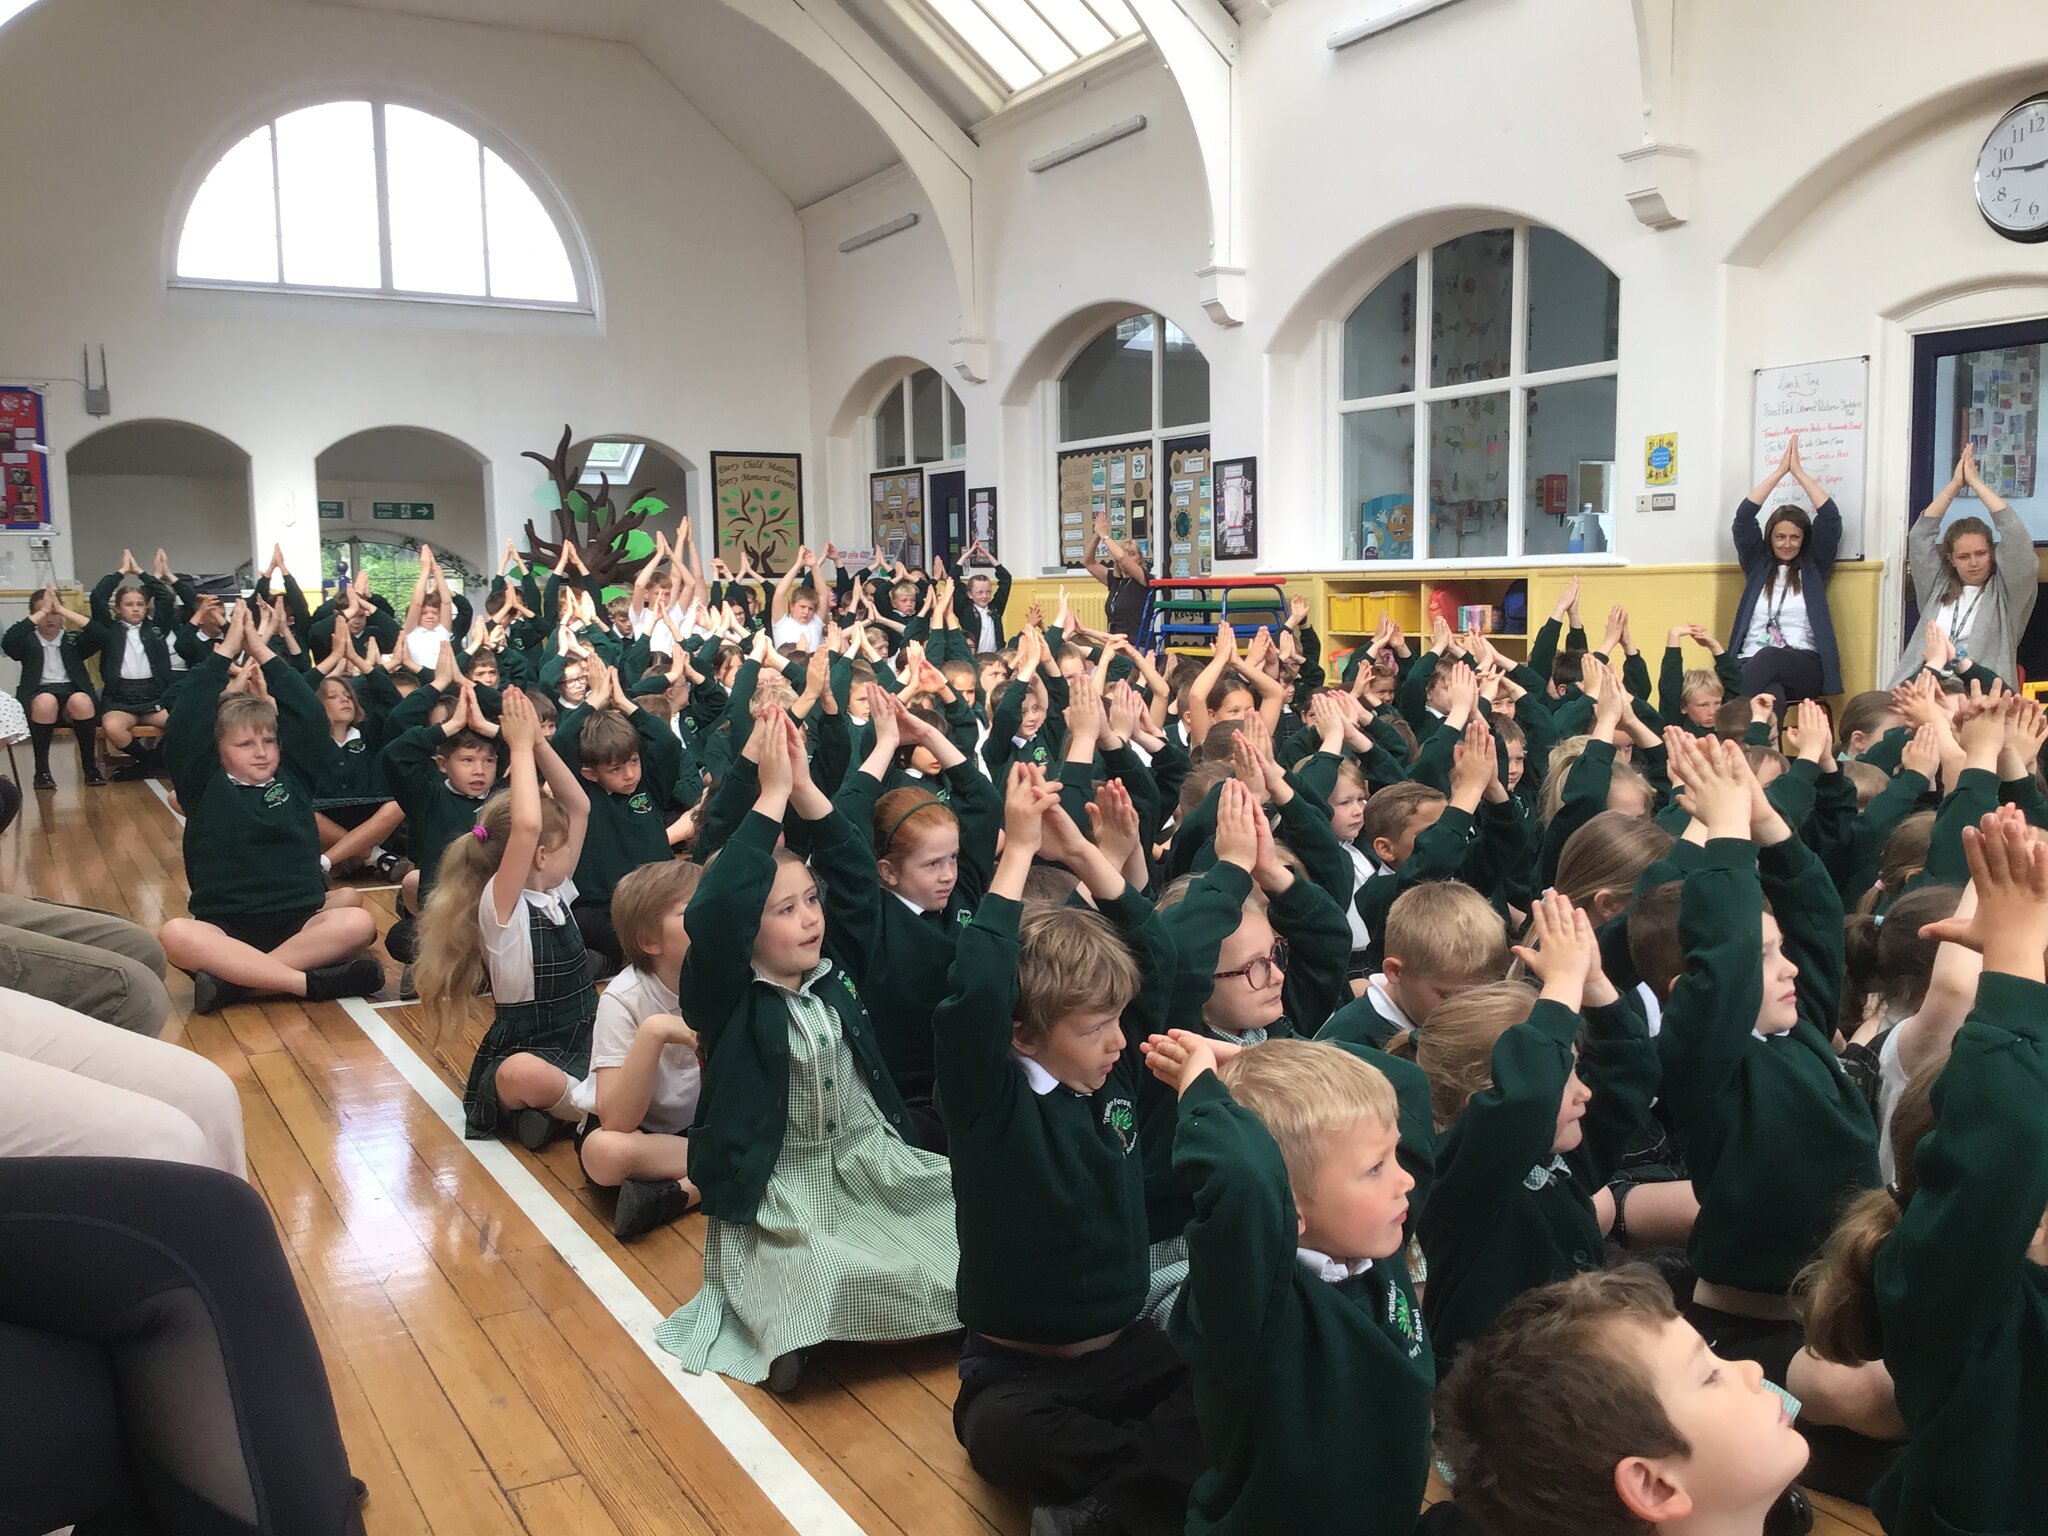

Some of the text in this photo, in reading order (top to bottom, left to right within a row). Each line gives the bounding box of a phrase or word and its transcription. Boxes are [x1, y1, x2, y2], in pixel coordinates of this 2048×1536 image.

[2029, 116, 2045, 133] 12
[2013, 127, 2024, 144] 11
[1998, 146, 2014, 163] 10
[1991, 167, 2002, 181] 9
[1997, 186, 2007, 202] 8
[2013, 197, 2022, 213] 7
[2028, 200, 2040, 216] 6
[743, 460, 764, 469] Child
[1412, 1308, 1423, 1342] School
